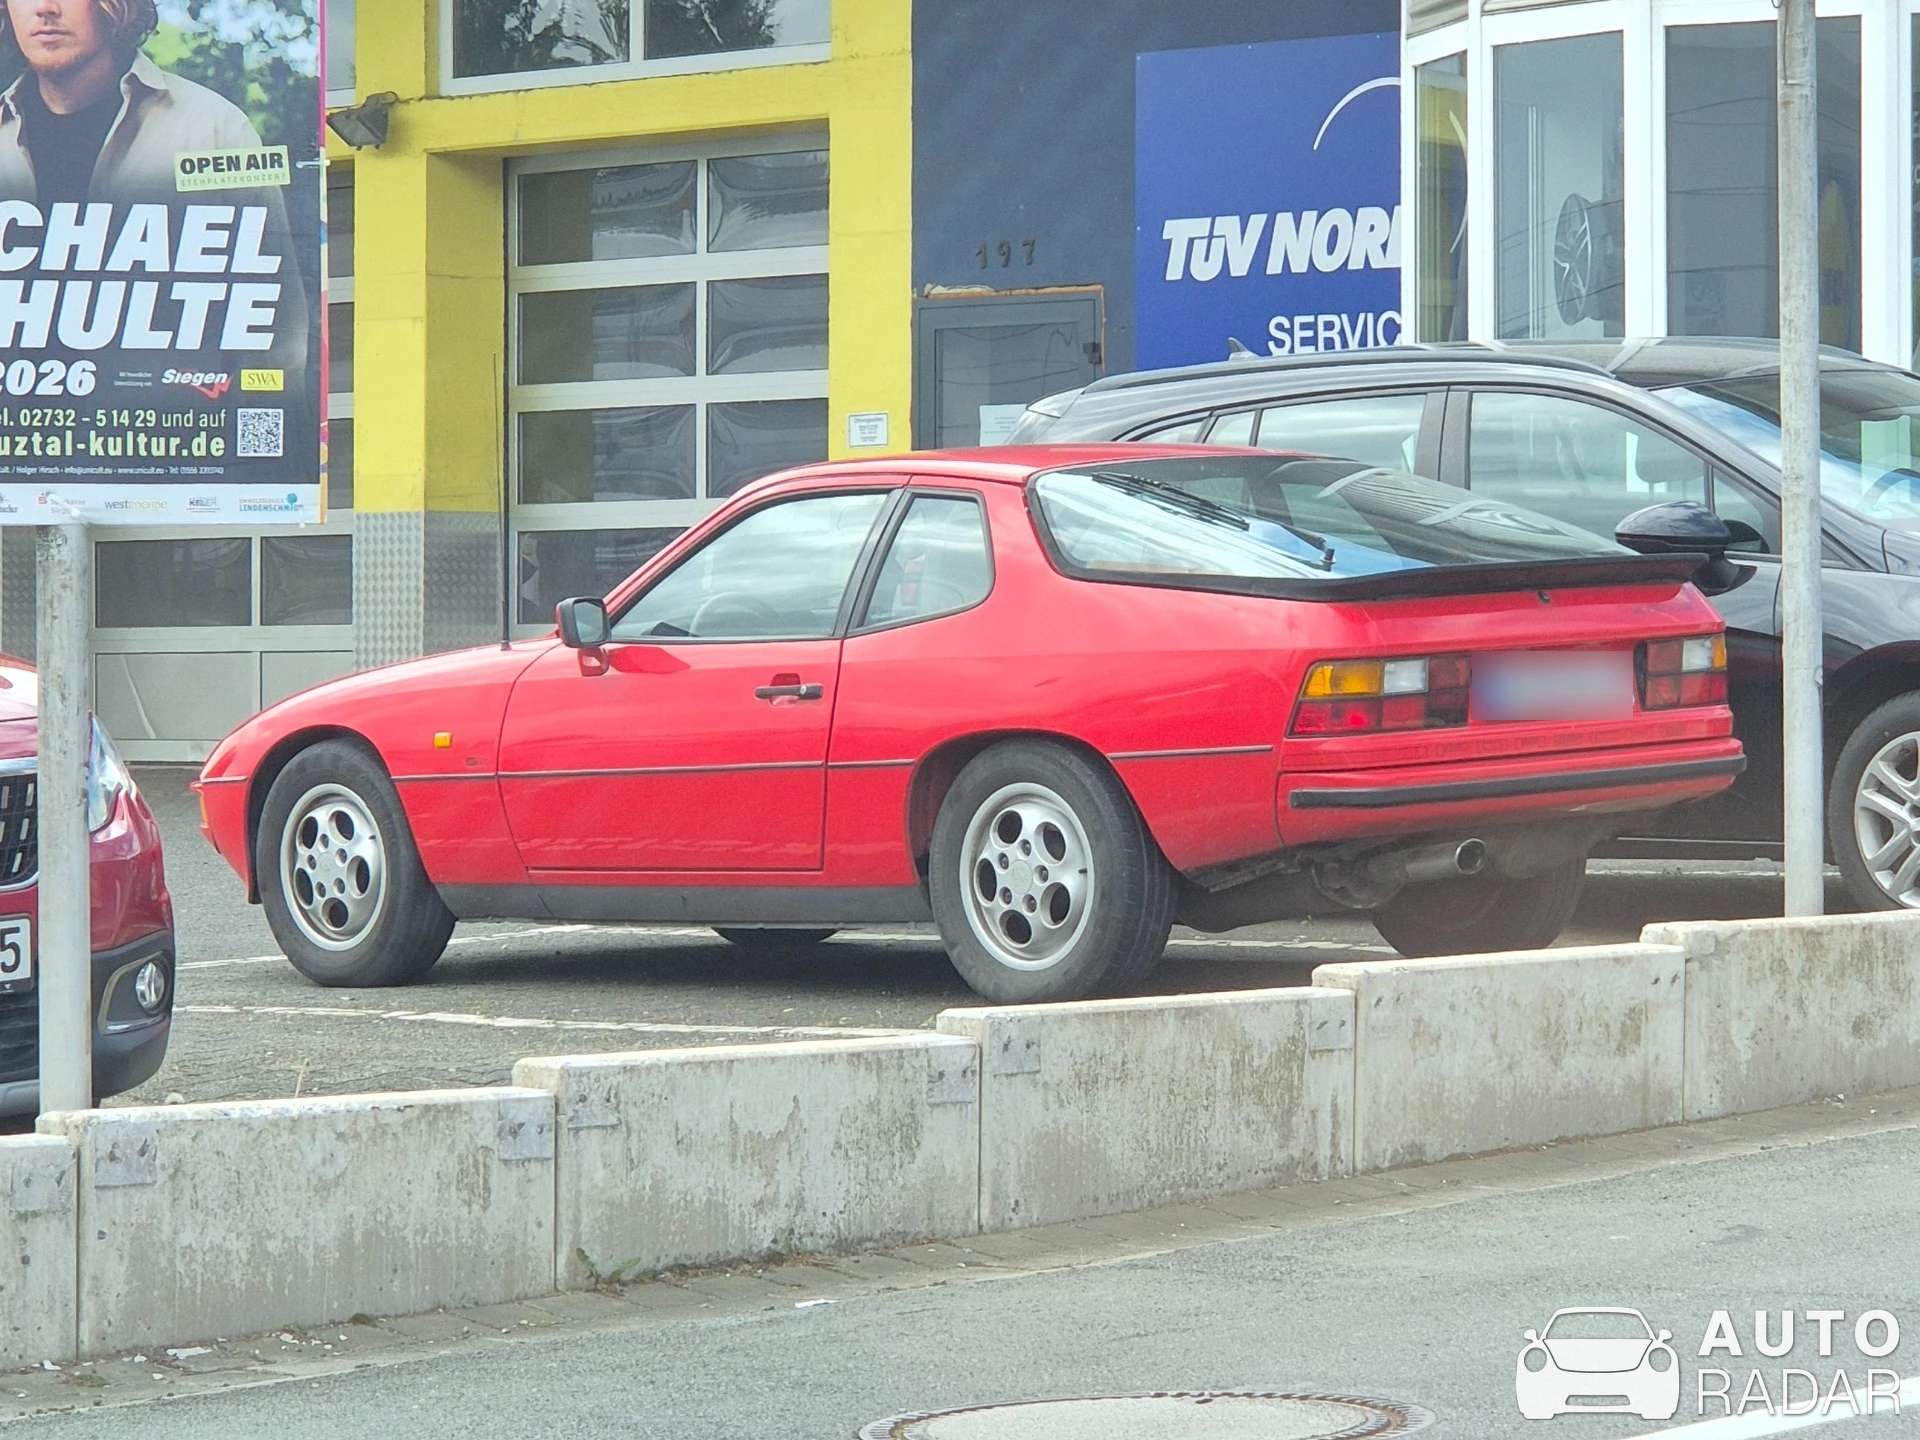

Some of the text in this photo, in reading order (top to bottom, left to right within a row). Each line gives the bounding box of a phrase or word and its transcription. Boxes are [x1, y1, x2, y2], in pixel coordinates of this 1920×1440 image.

[180, 152, 284, 175] OPEN AIR
[181, 173, 286, 187] STEHPLATZKONZERT
[0, 199, 282, 273] CHAEL
[1162, 213, 1268, 282] TÜV
[976, 239, 1036, 269] 197
[0, 279, 282, 351] HULTE
[0, 359, 97, 397] 026
[161, 368, 229, 387] Siegen
[247, 372, 278, 386] SWA
[20, 408, 77, 427] 02732
[95, 409, 107, 427] 5
[111, 409, 130, 427] 14
[134, 409, 157, 427] 29
[162, 408, 194, 428] und
[198, 408, 227, 428] auf
